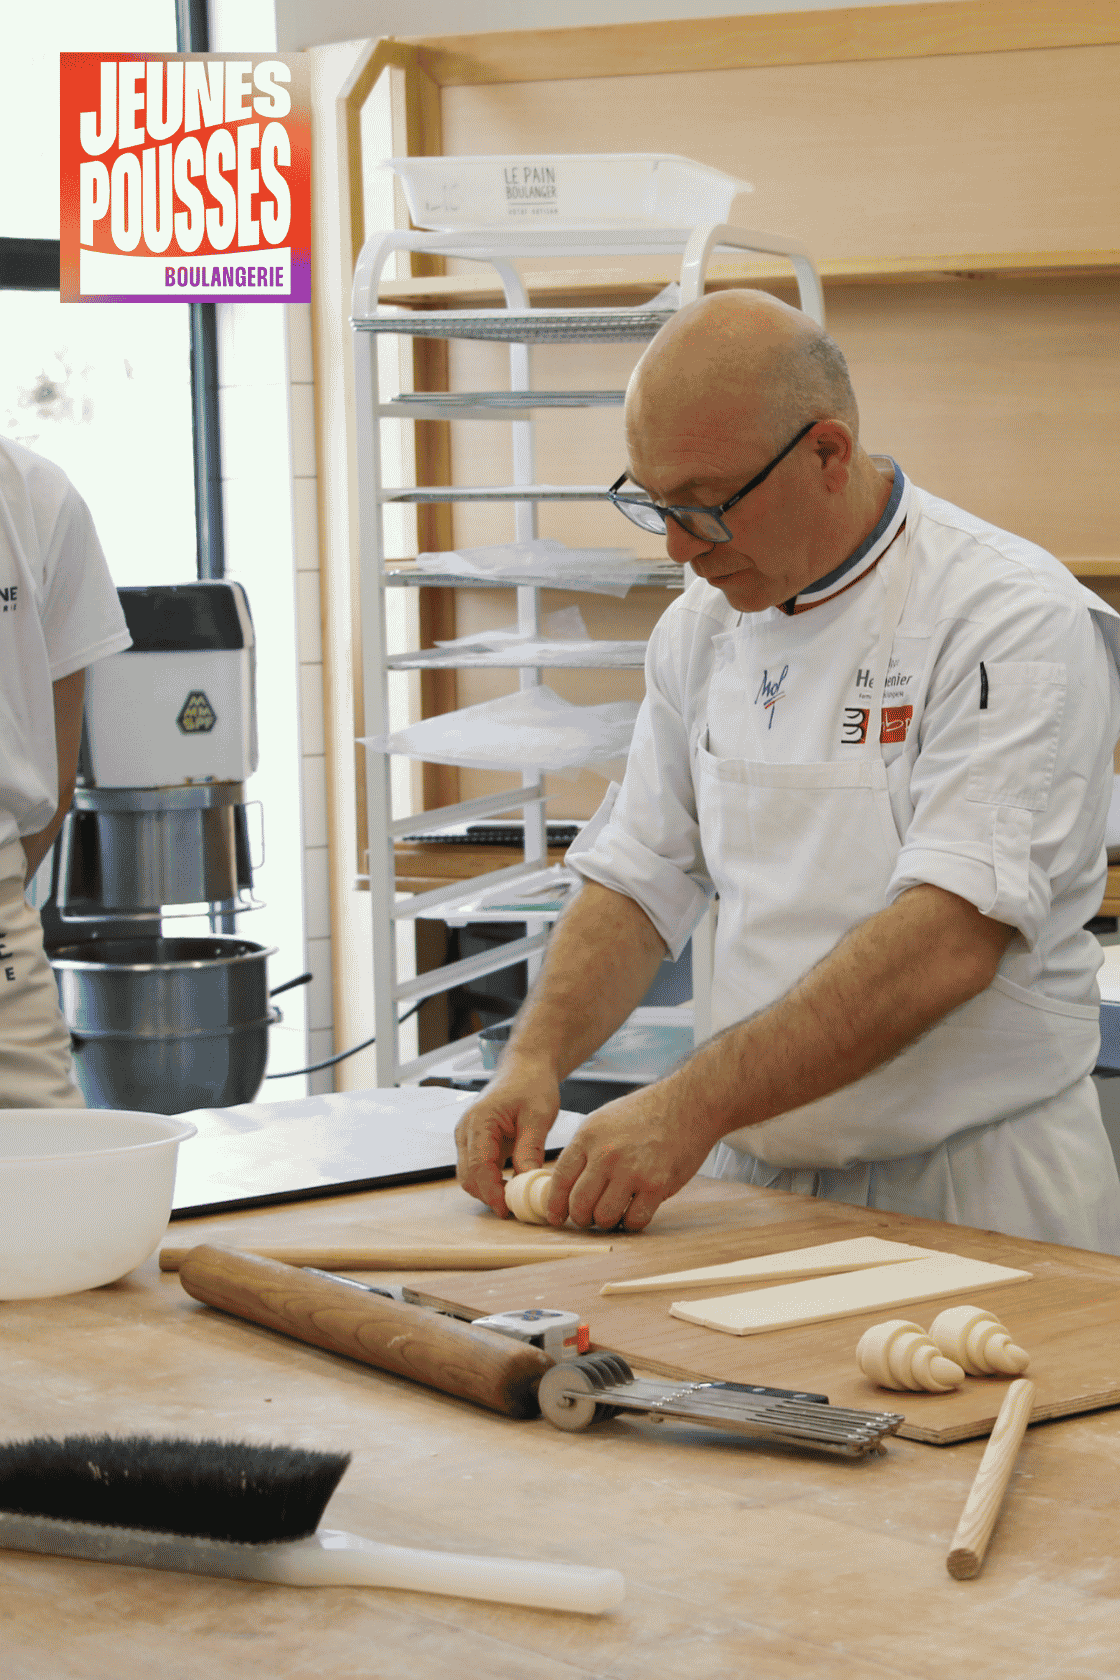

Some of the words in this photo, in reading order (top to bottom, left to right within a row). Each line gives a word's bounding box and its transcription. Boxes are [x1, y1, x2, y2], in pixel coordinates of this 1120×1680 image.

[504, 167, 519, 184] LE
[523, 167, 556, 184] PAIN
[506, 185, 557, 199] BOULANGER
